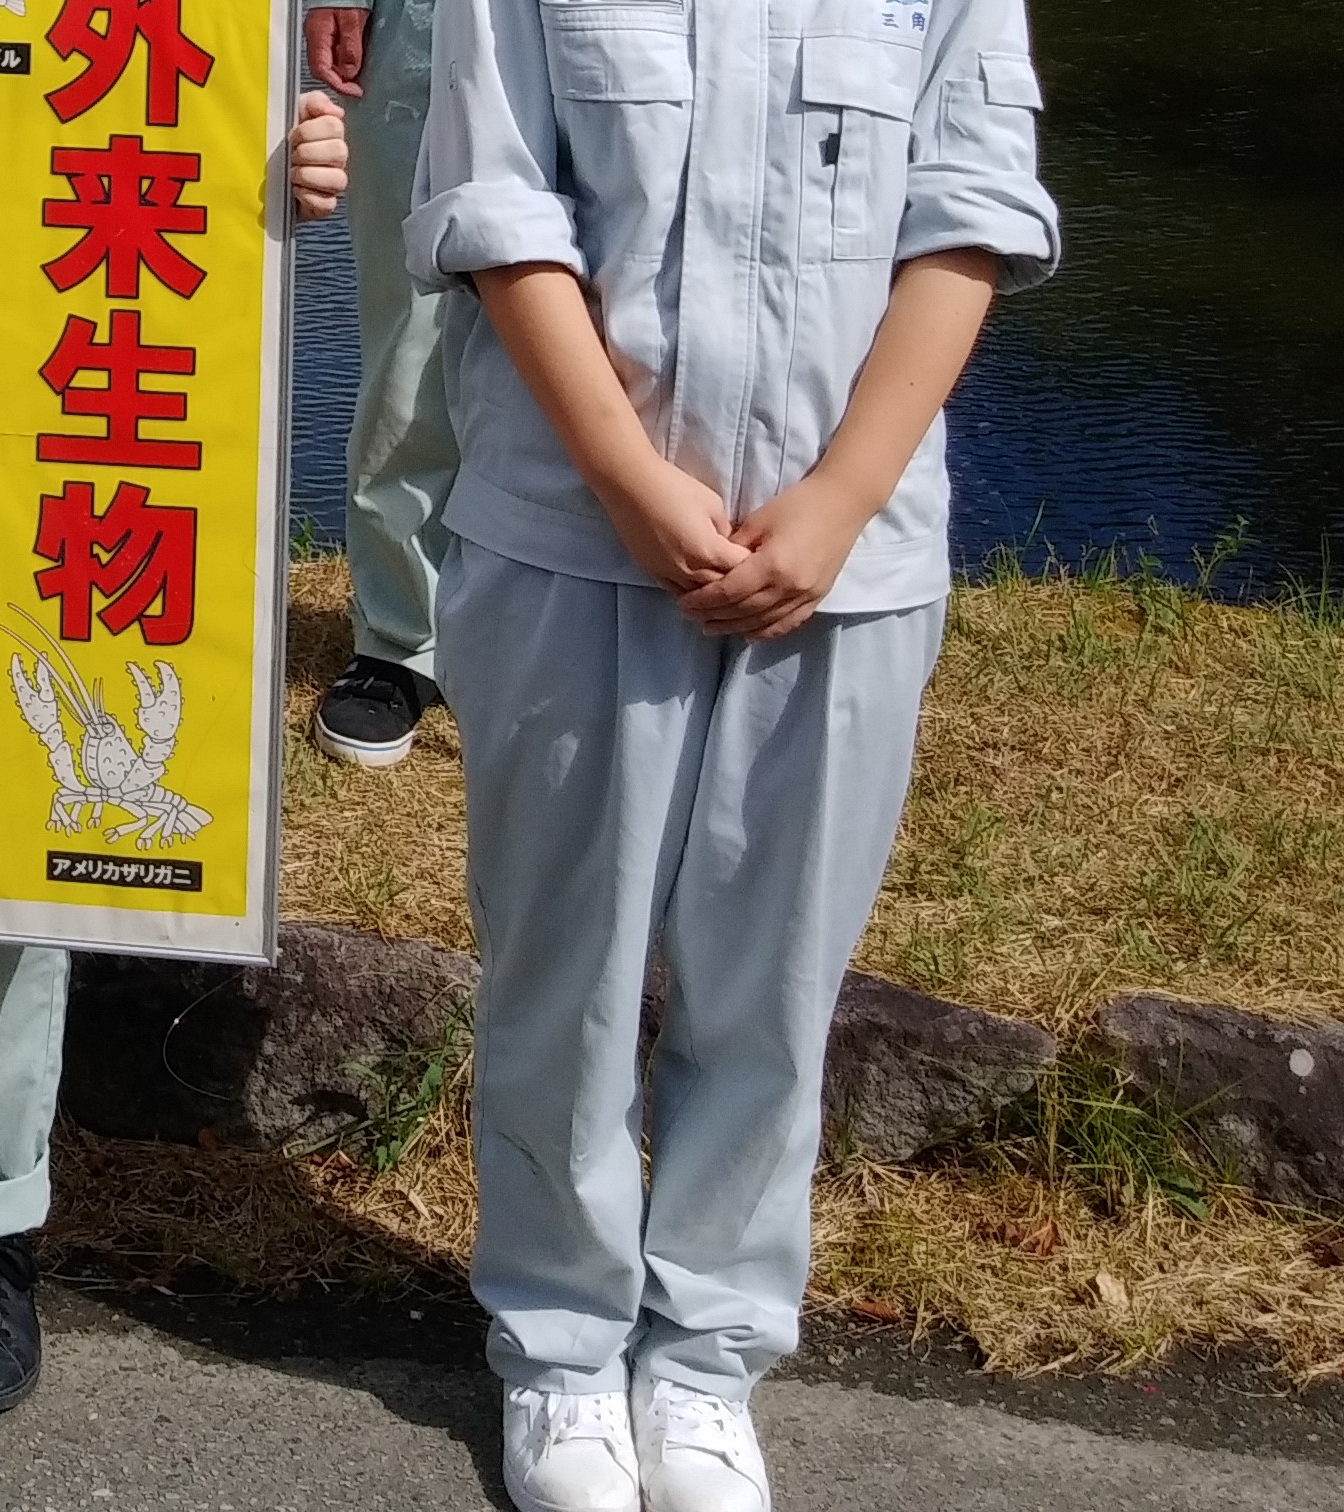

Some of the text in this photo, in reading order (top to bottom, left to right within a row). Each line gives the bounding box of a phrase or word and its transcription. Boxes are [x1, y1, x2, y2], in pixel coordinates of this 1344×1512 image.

[881, 11, 926, 32] 三角
[52, 858, 192, 885] アメリカザリガニ
